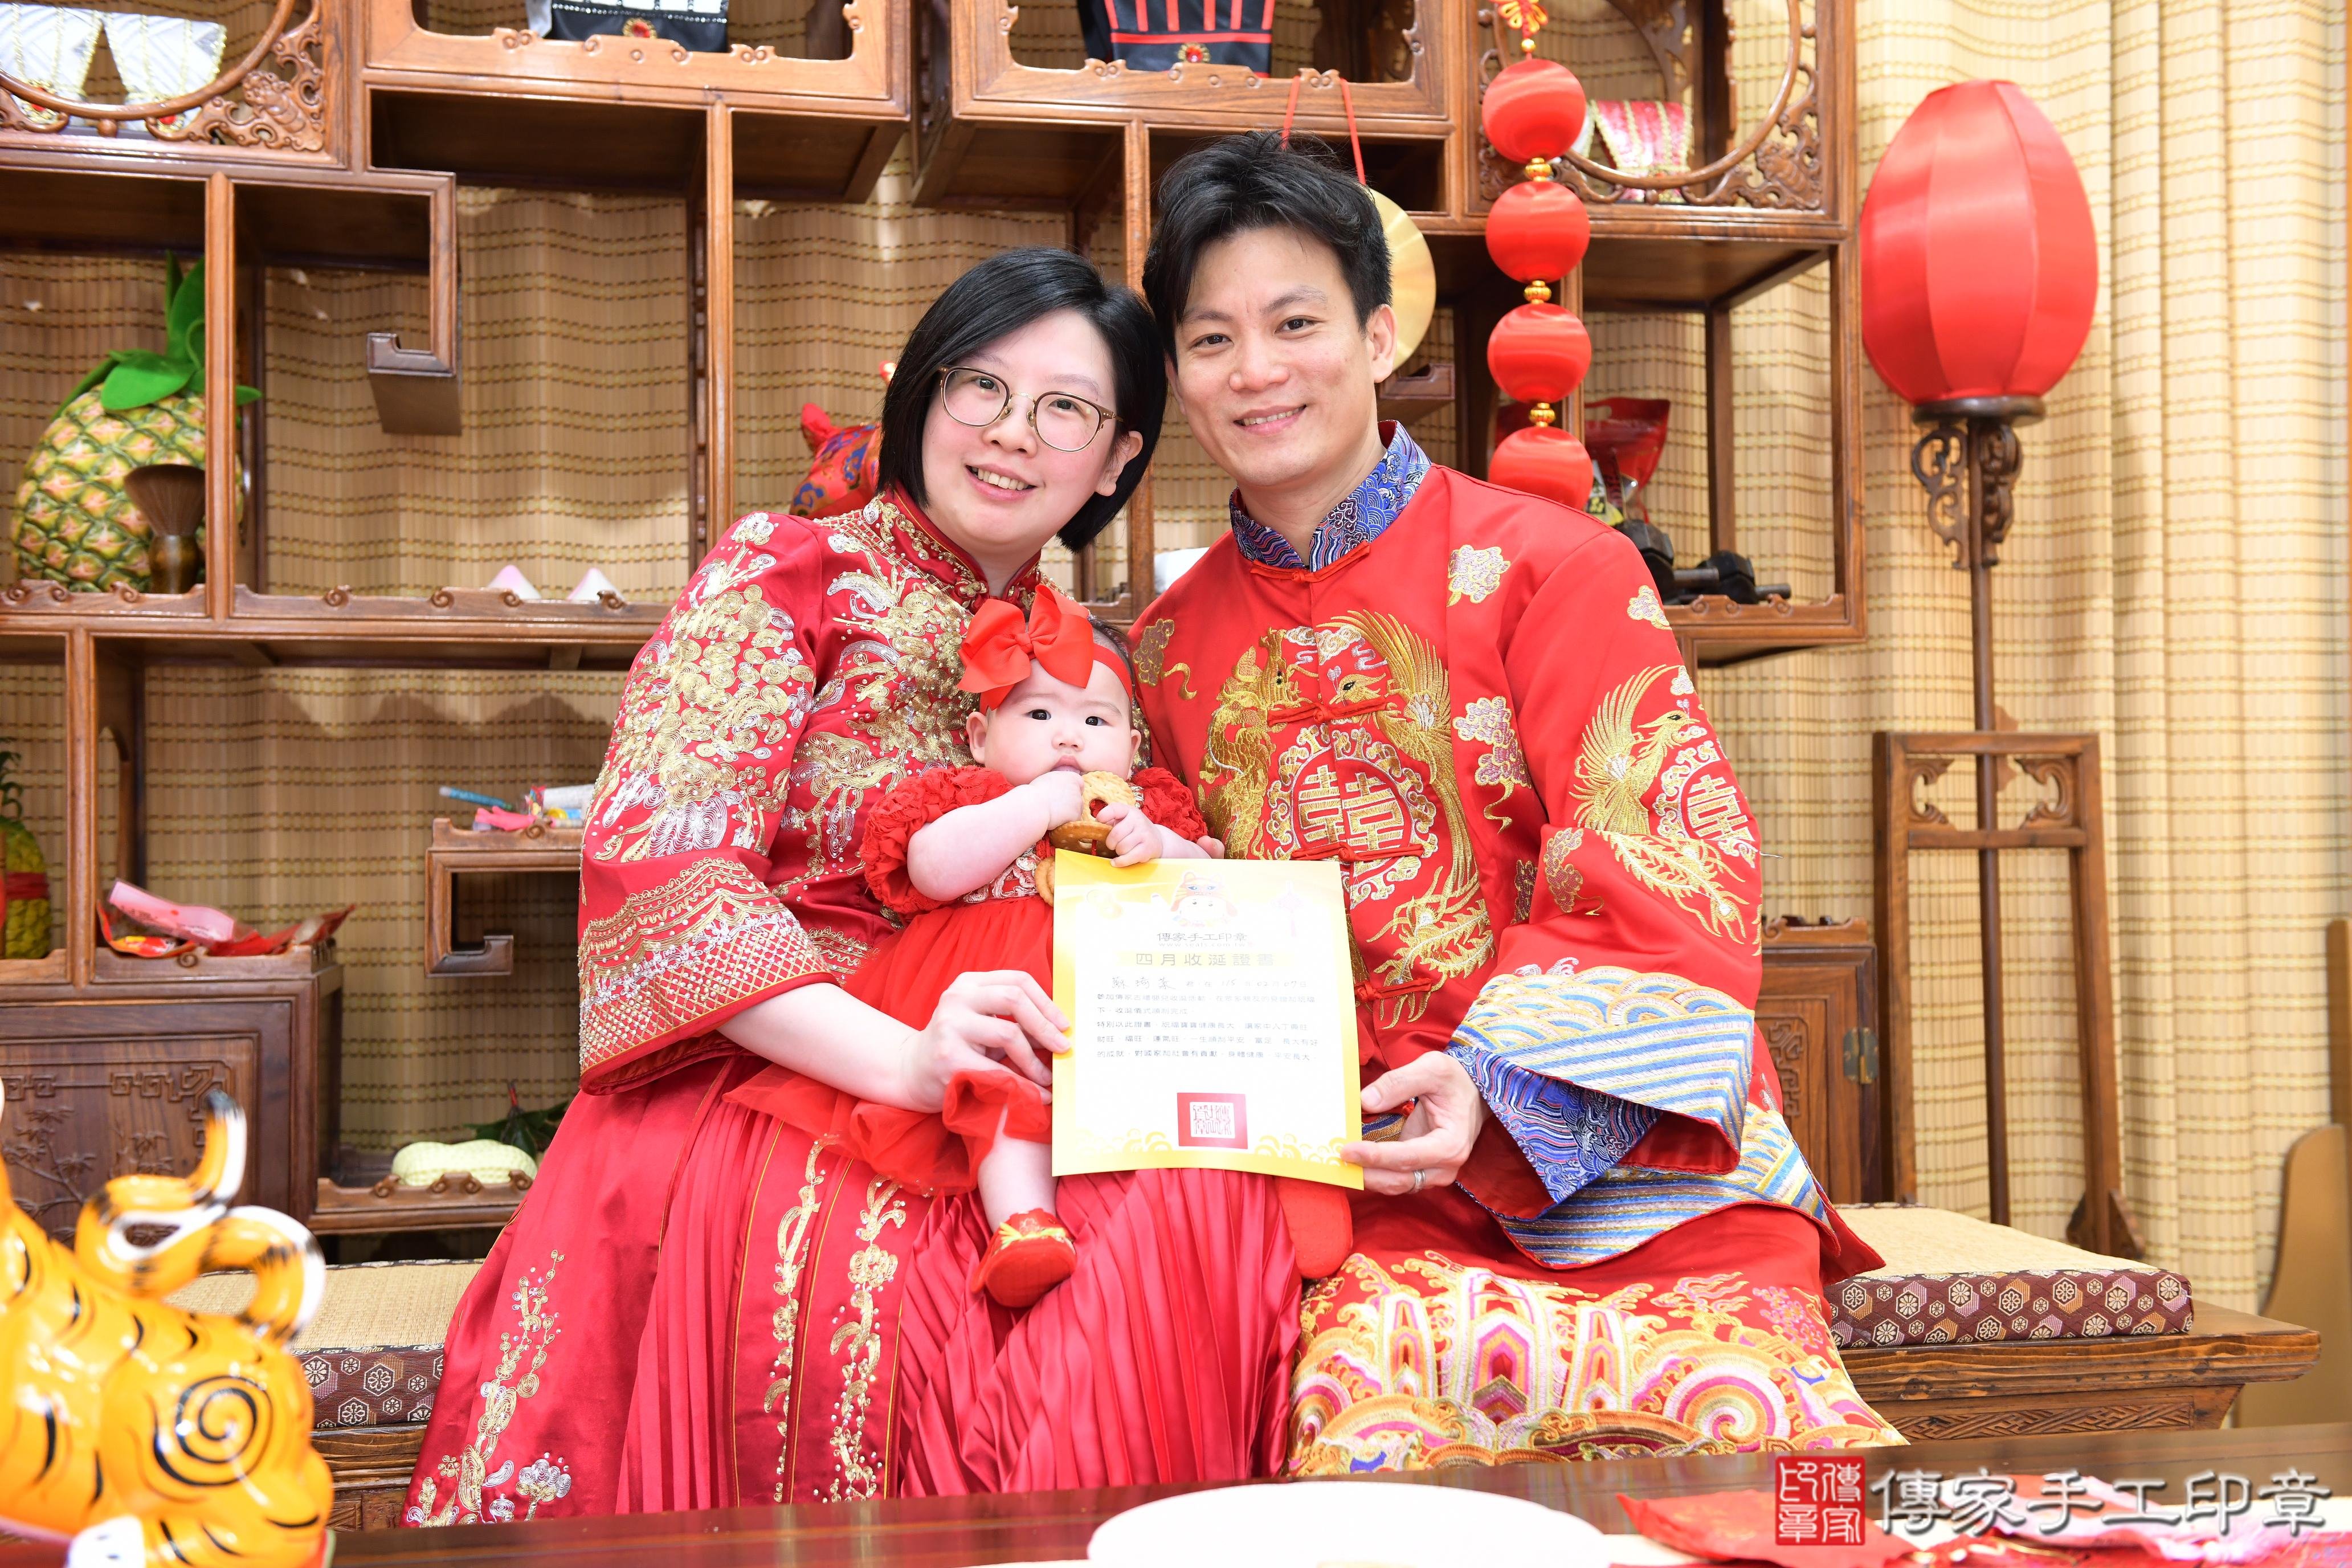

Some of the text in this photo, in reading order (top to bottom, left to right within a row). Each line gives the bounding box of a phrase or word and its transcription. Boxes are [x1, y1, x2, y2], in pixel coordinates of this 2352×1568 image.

[1157, 932, 1248, 941] 傳家手工印章
[1136, 953, 1274, 966] 四月收涎證書
